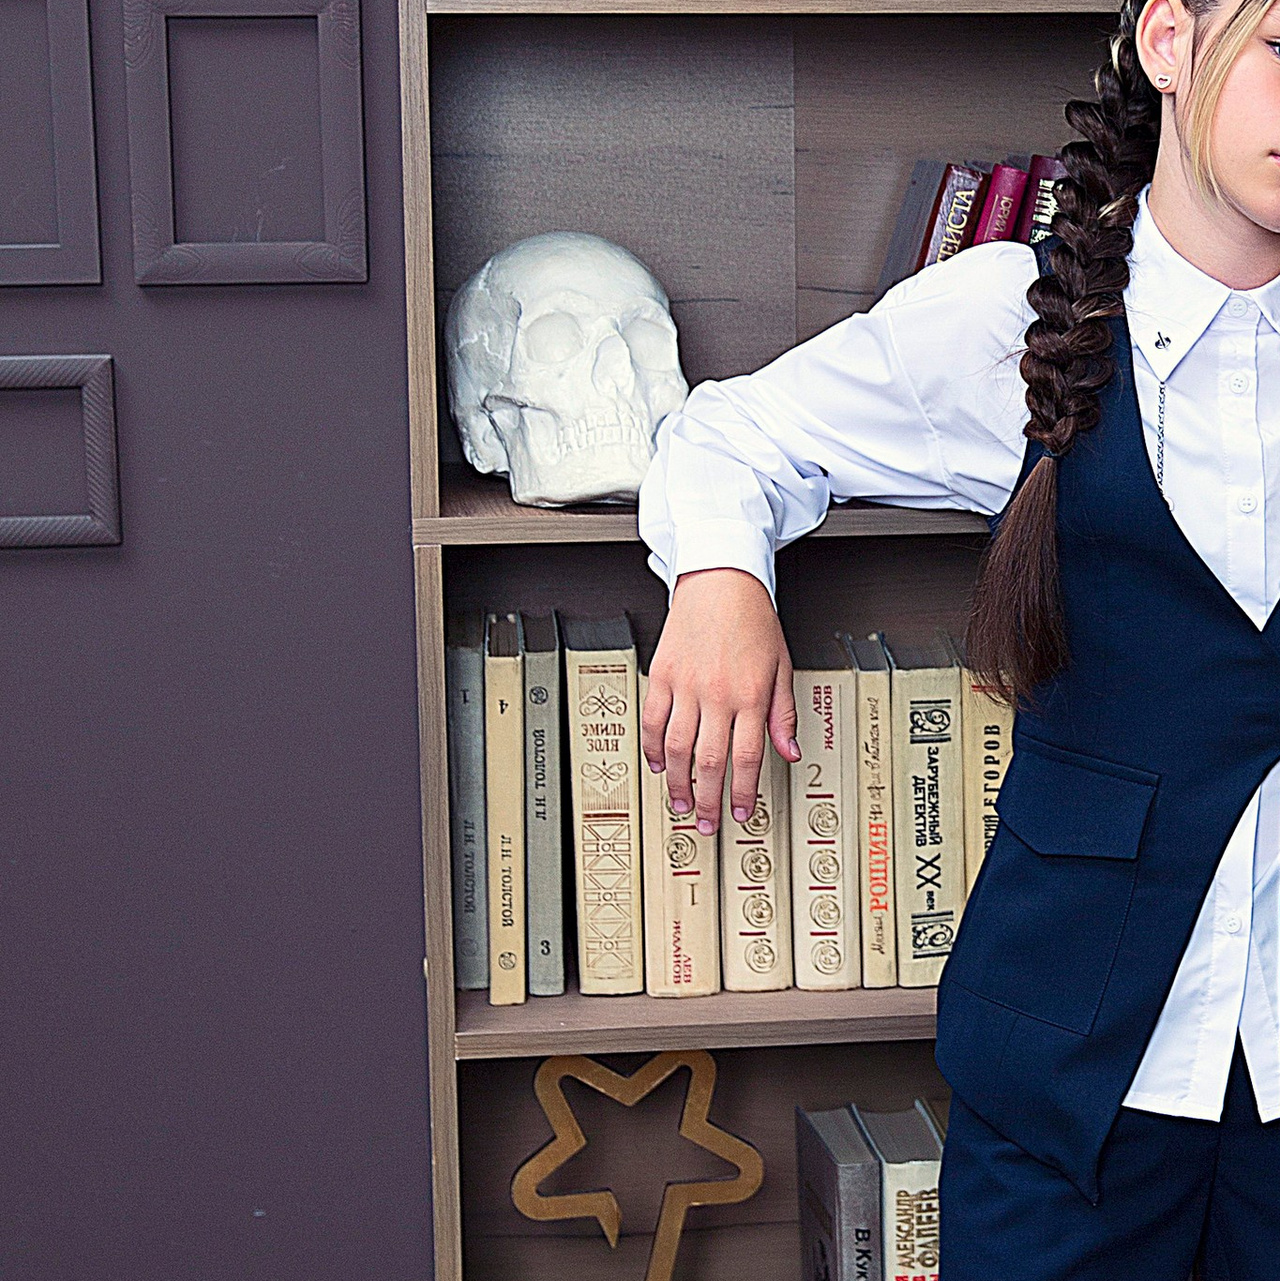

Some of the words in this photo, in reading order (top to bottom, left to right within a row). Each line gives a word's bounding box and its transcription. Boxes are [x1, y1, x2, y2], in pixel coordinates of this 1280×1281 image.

[498, 699, 509, 715] 4
[581, 723, 626, 738] ЭМИЛЬ
[812, 684, 822, 716] ЛЕВ
[823, 685, 833, 750] ЖДАНОВ
[533, 728, 546, 790] ТОЛСТОЙ
[585, 738, 620, 753] ЗОЛЯ
[806, 763, 823, 788] 2
[984, 724, 1001, 807] ЕГОРОВ
[912, 775, 927, 847] ДЕТЕКТИВ
[926, 746, 943, 846] ЗАРУБЕЖНЫЙ
[463, 852, 475, 914] ТОЛСТОЙ
[501, 866, 514, 927] ТОЛСТОЙ
[687, 882, 699, 906] 1
[868, 821, 890, 912] РОЩИН
[926, 890, 935, 911] век
[540, 939, 551, 957] 3
[895, 1189, 916, 1269] АЛЕКСАНДР
